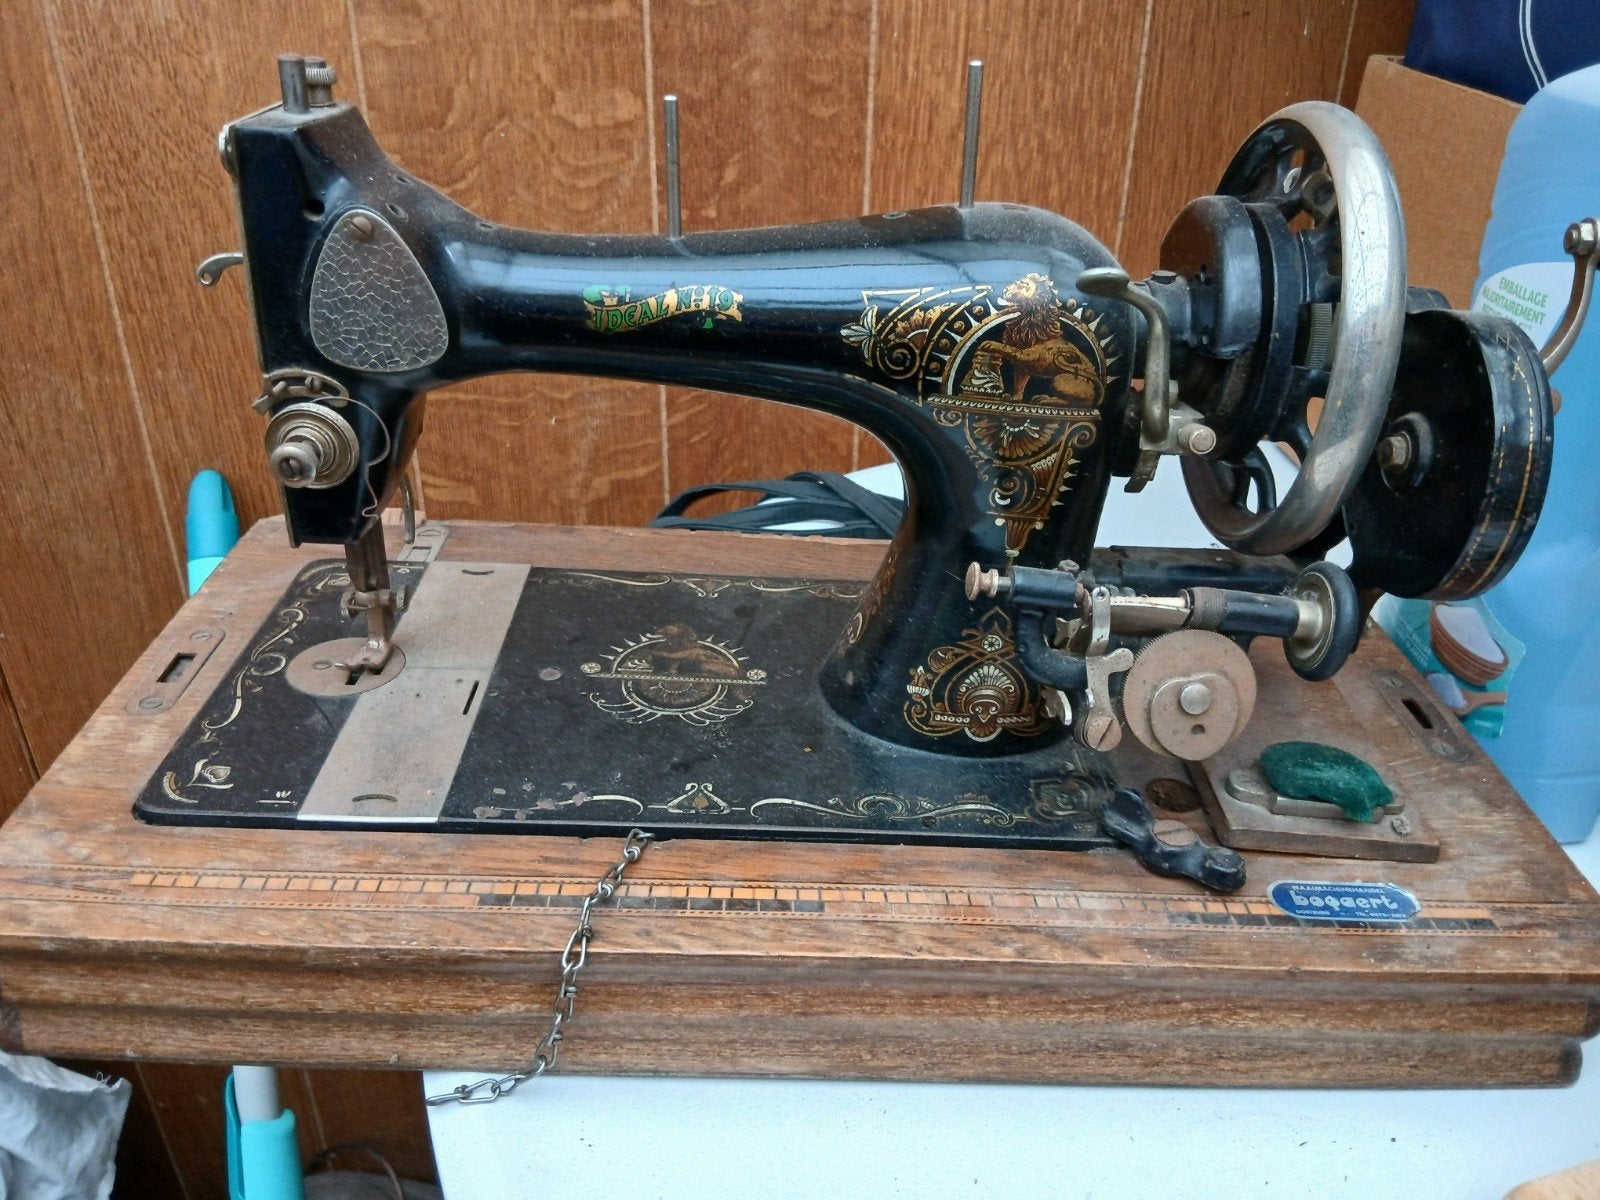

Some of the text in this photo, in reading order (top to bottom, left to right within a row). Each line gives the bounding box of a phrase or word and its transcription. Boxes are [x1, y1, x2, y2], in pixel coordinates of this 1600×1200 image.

[1499, 276, 1548, 308] EMBALLAGE
[594, 294, 669, 330] IDEAL
[1289, 889, 1398, 911] bogaert
